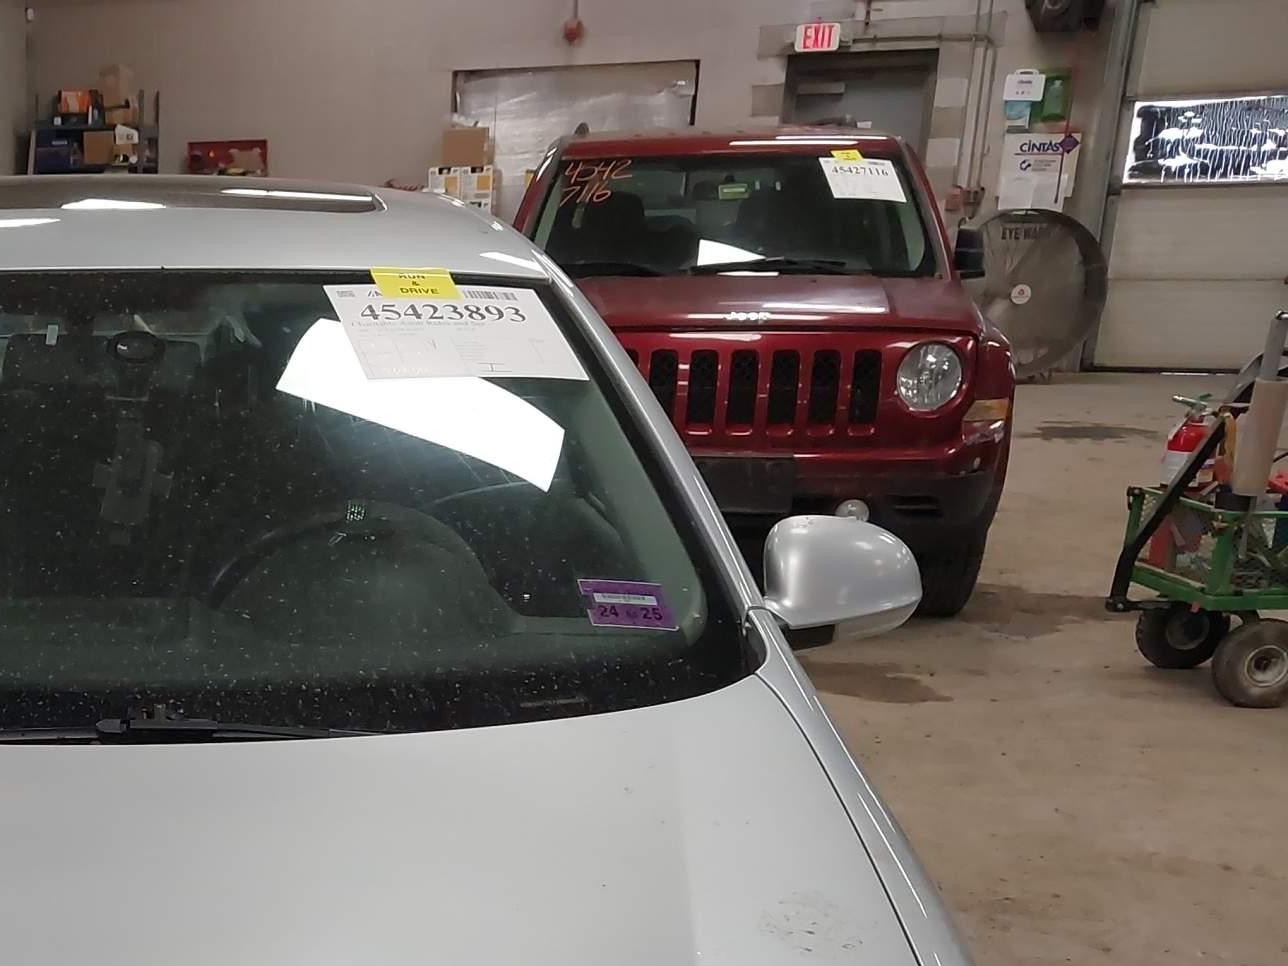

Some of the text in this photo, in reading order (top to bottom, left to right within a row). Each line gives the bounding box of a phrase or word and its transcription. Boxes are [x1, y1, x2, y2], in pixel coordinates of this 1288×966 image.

[802, 24, 835, 49] EXIT
[1019, 139, 1062, 153] CINTAS
[564, 159, 633, 184] 4542
[831, 166, 889, 177] 45427116
[560, 180, 612, 207] 7116
[1001, 226, 1020, 240] EYE
[399, 286, 440, 295] DRIVE
[360, 303, 527, 323] 45423893
[598, 604, 620, 618] 24
[640, 606, 663, 620] 25
